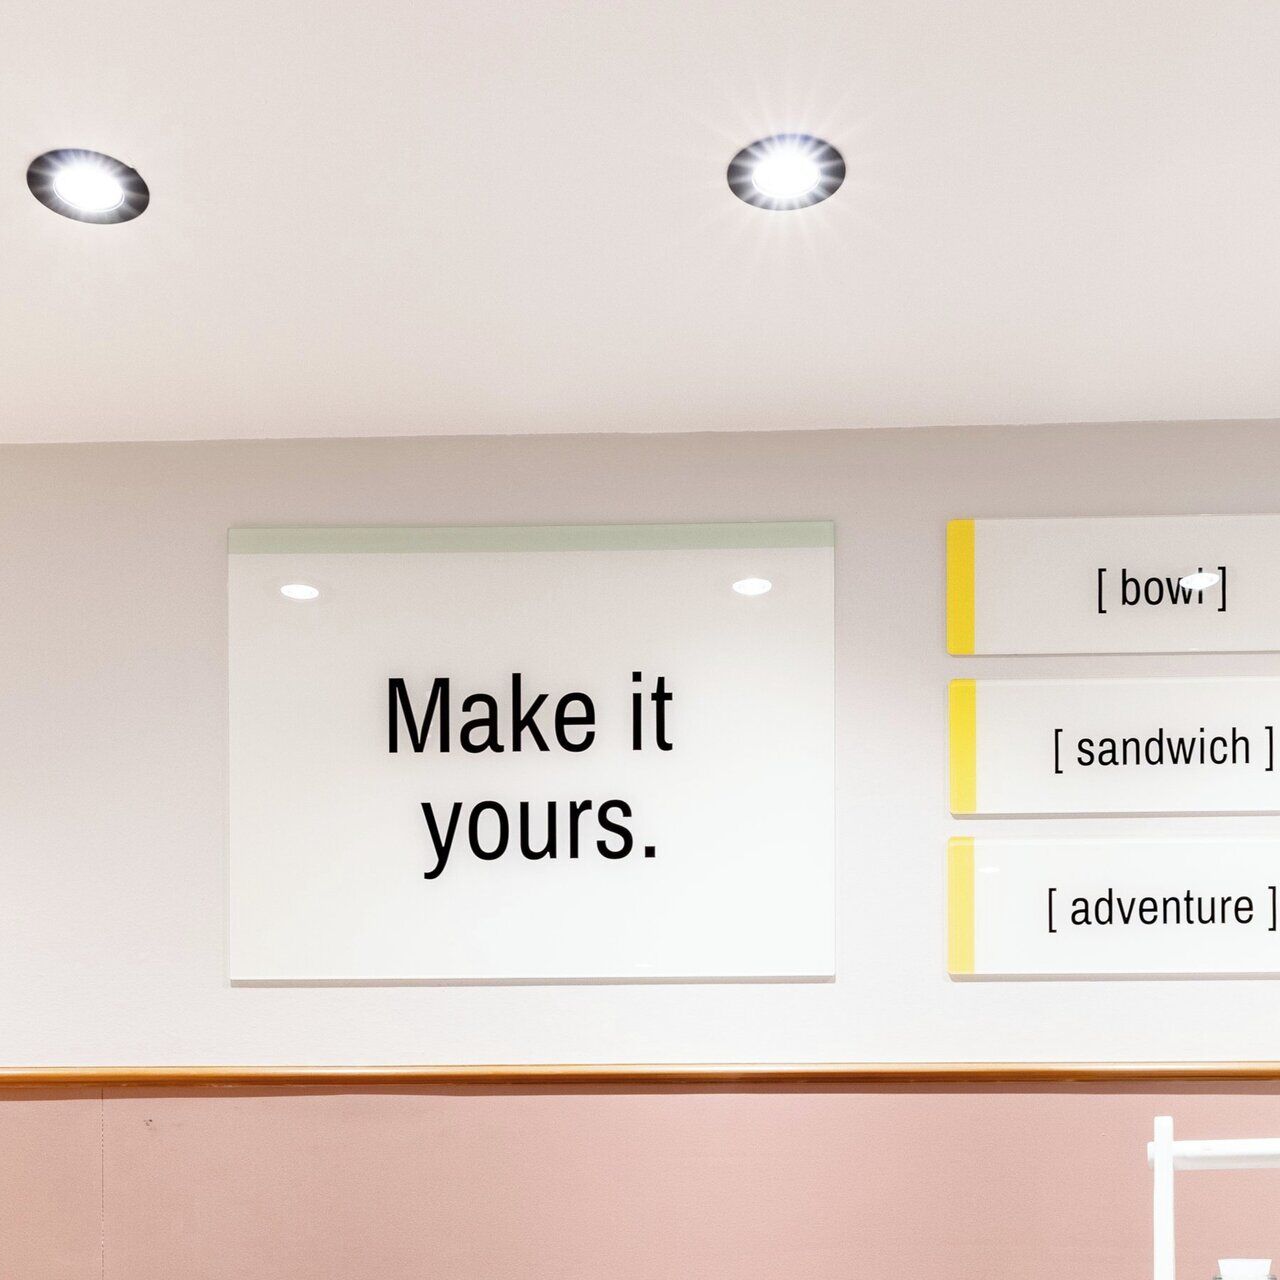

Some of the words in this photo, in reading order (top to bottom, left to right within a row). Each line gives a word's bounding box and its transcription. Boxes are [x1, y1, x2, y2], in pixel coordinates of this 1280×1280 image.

[388, 672, 596, 753] Make
[632, 671, 673, 751] it
[1077, 727, 1250, 766] sandwich
[420, 799, 656, 880] yours.
[1070, 888, 1254, 926] adventure
